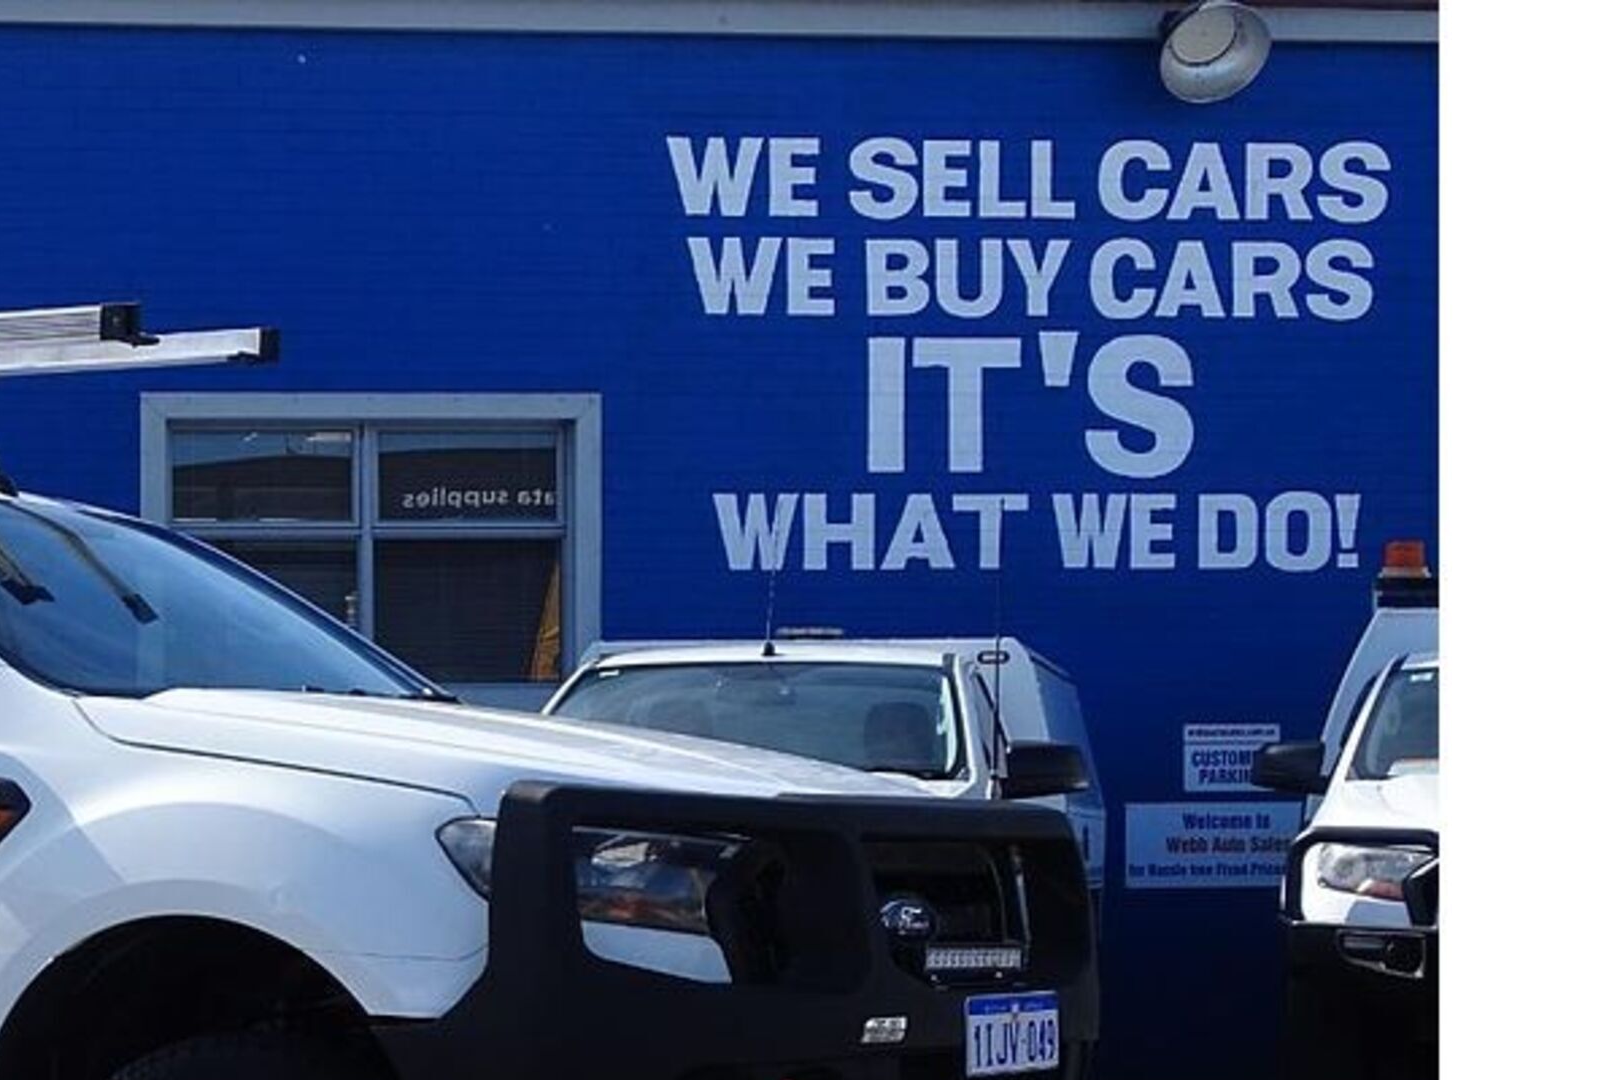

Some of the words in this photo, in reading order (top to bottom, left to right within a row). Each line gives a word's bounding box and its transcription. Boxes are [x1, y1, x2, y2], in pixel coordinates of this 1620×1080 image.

[666, 137, 819, 218] WE
[849, 138, 1075, 220] SELL
[1097, 141, 1392, 223] CARS
[687, 237, 835, 316] WE
[864, 238, 1073, 317] BUY
[1089, 238, 1374, 321] CARS
[866, 330, 1195, 479] IT'S
[712, 493, 1029, 571] WHAT
[1052, 493, 1176, 570] WE
[1198, 491, 1362, 573] DO!
[1191, 751, 1252, 768] CUSTOM
[1198, 768, 1253, 785] PARKIN
[1166, 836, 1208, 853] Webb
[1182, 813, 1252, 829] Welcome
